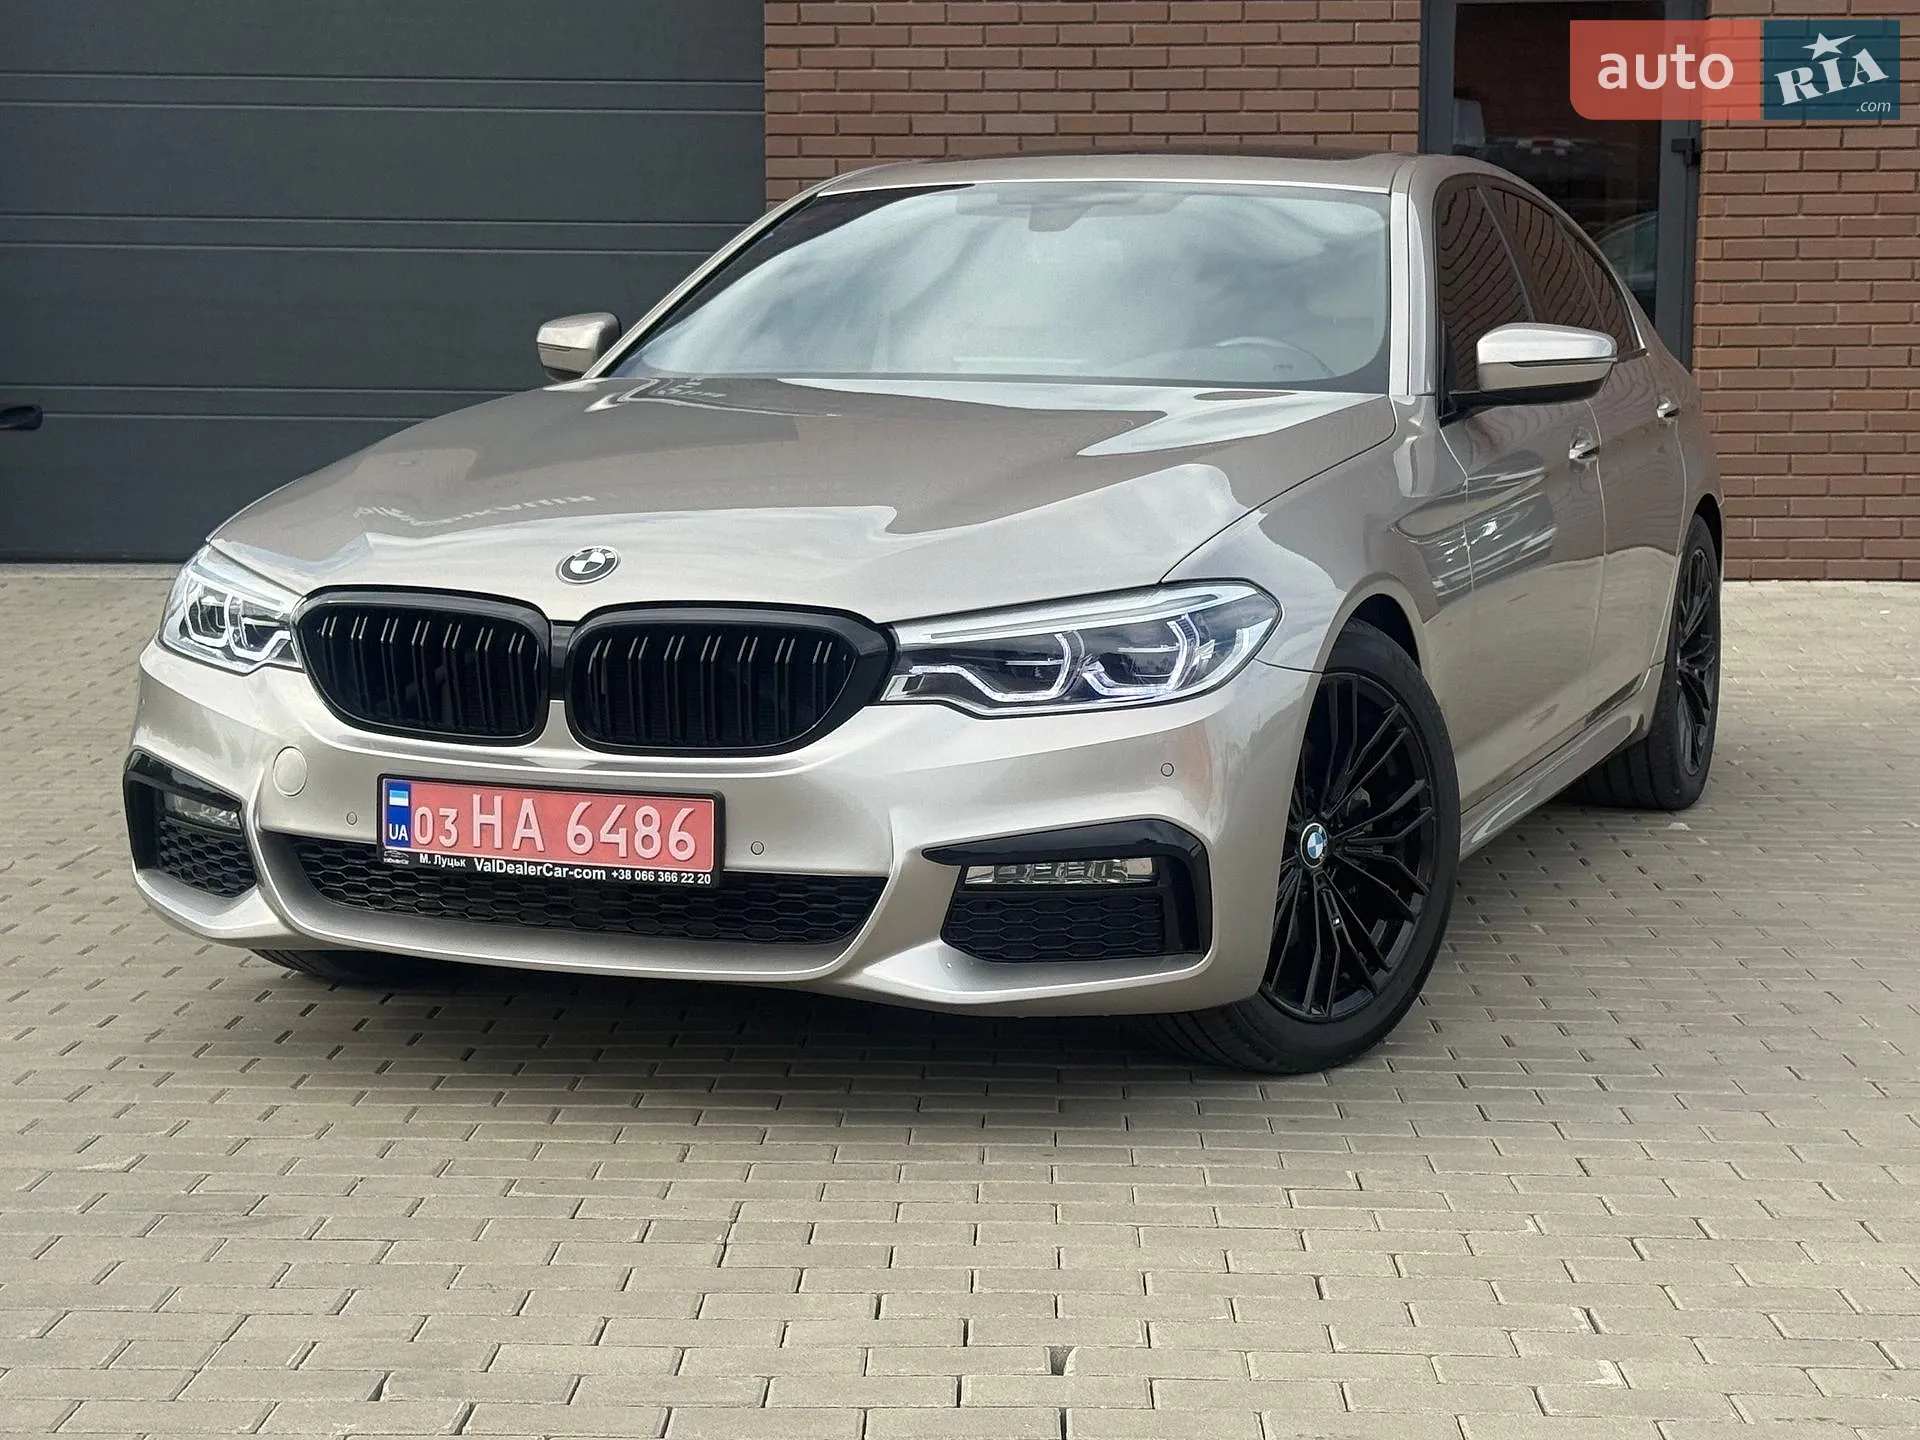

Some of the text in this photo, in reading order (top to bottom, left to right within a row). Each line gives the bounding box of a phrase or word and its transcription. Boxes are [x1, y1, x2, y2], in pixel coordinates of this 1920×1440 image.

[389, 823, 409, 842] UA
[414, 793, 696, 862] 03 HA 6486
[433, 854, 467, 868] Луцьк
[473, 857, 711, 885] ValDealerCar-com +38 066 366 22 20
